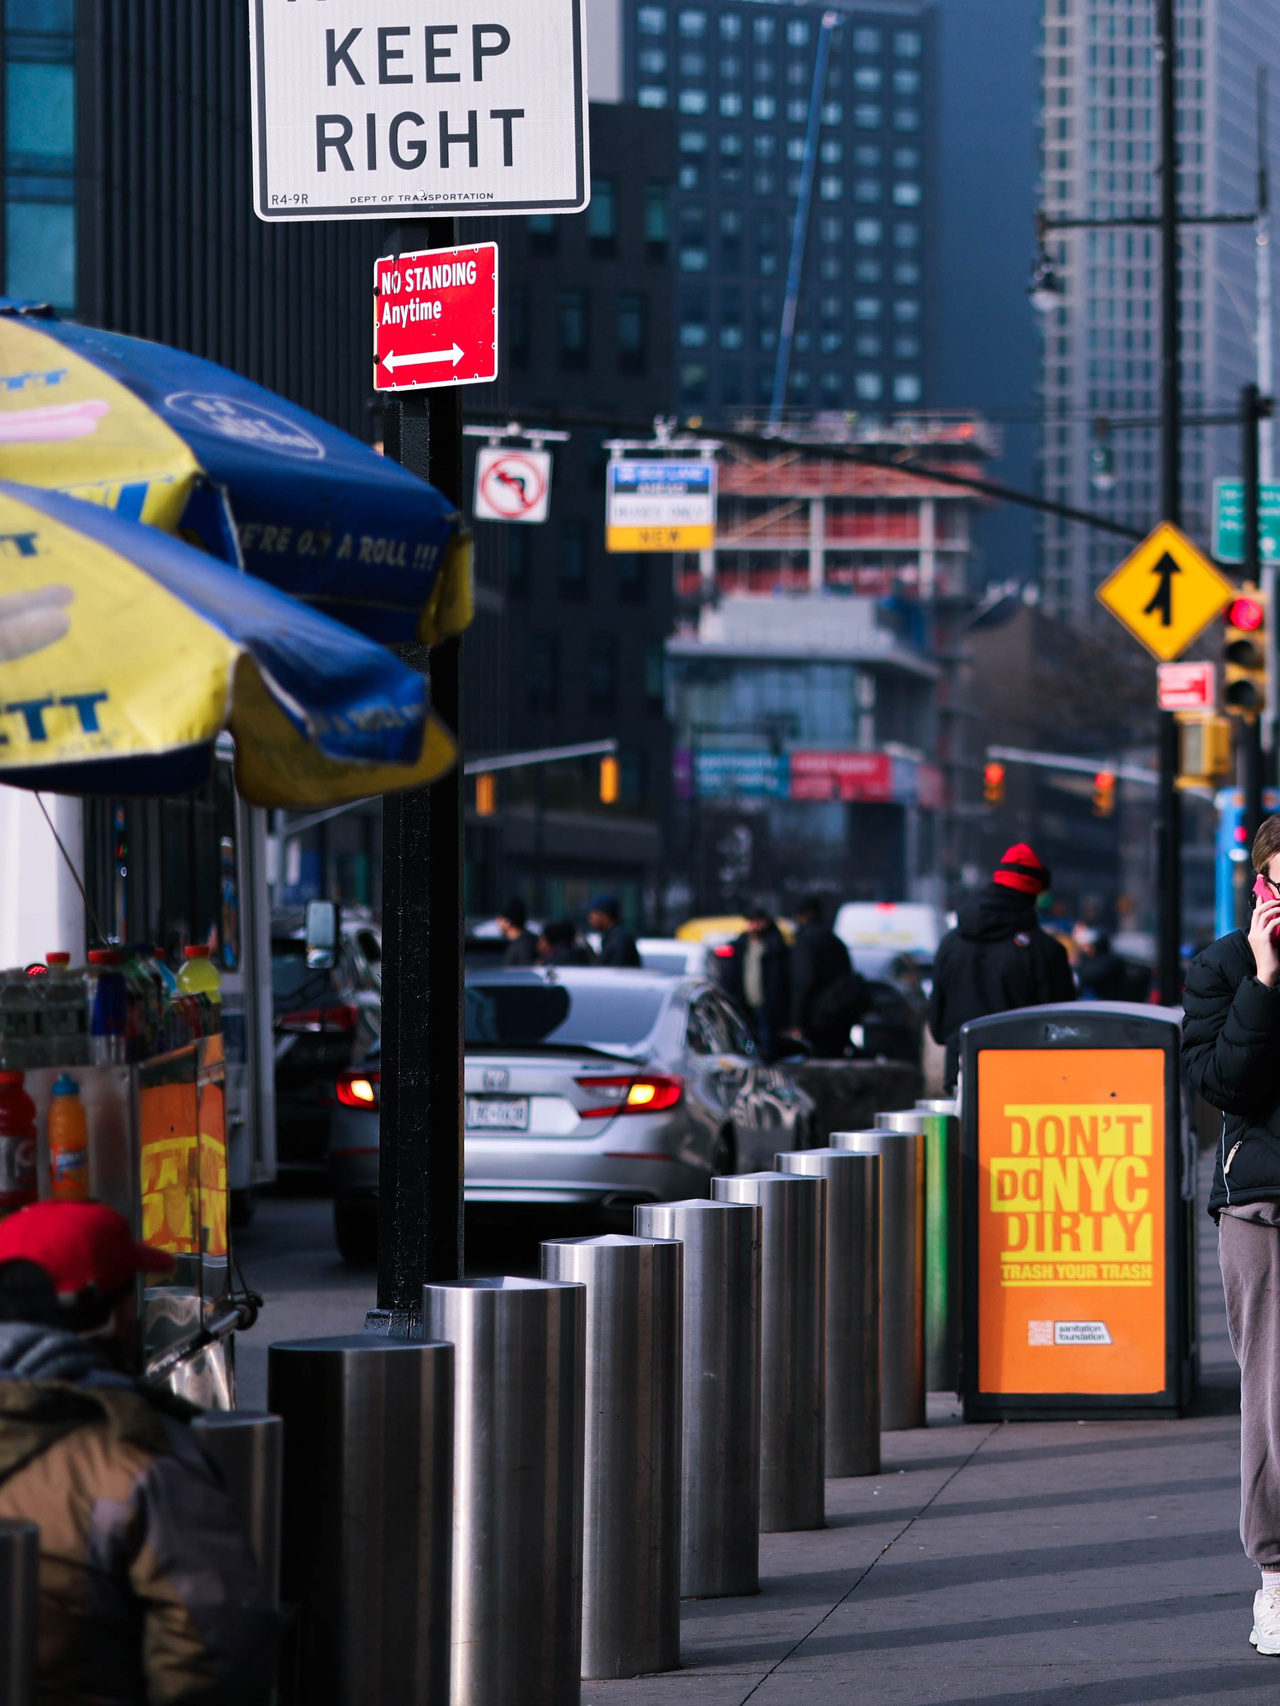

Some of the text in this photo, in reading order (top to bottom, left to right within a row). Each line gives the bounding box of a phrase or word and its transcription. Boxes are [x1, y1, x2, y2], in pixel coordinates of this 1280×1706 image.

[325, 23, 511, 86] KEEP
[315, 108, 525, 172] RIGHT
[271, 193, 309, 205] R4-9R
[350, 192, 494, 204] DEPT OF TRANSPORTATION
[381, 260, 477, 296] NO STANDING
[381, 297, 442, 328] Anytime
[238, 523, 295, 556] E'RE
[335, 533, 353, 561] A
[358, 536, 407, 569] ROLL
[1004, 1114, 1145, 1158] DON'T
[998, 1156, 1150, 1213] DO NYC
[1002, 1212, 1146, 1253] DIRTY
[1002, 1263, 1153, 1280] TRASH YOUR TRASH
